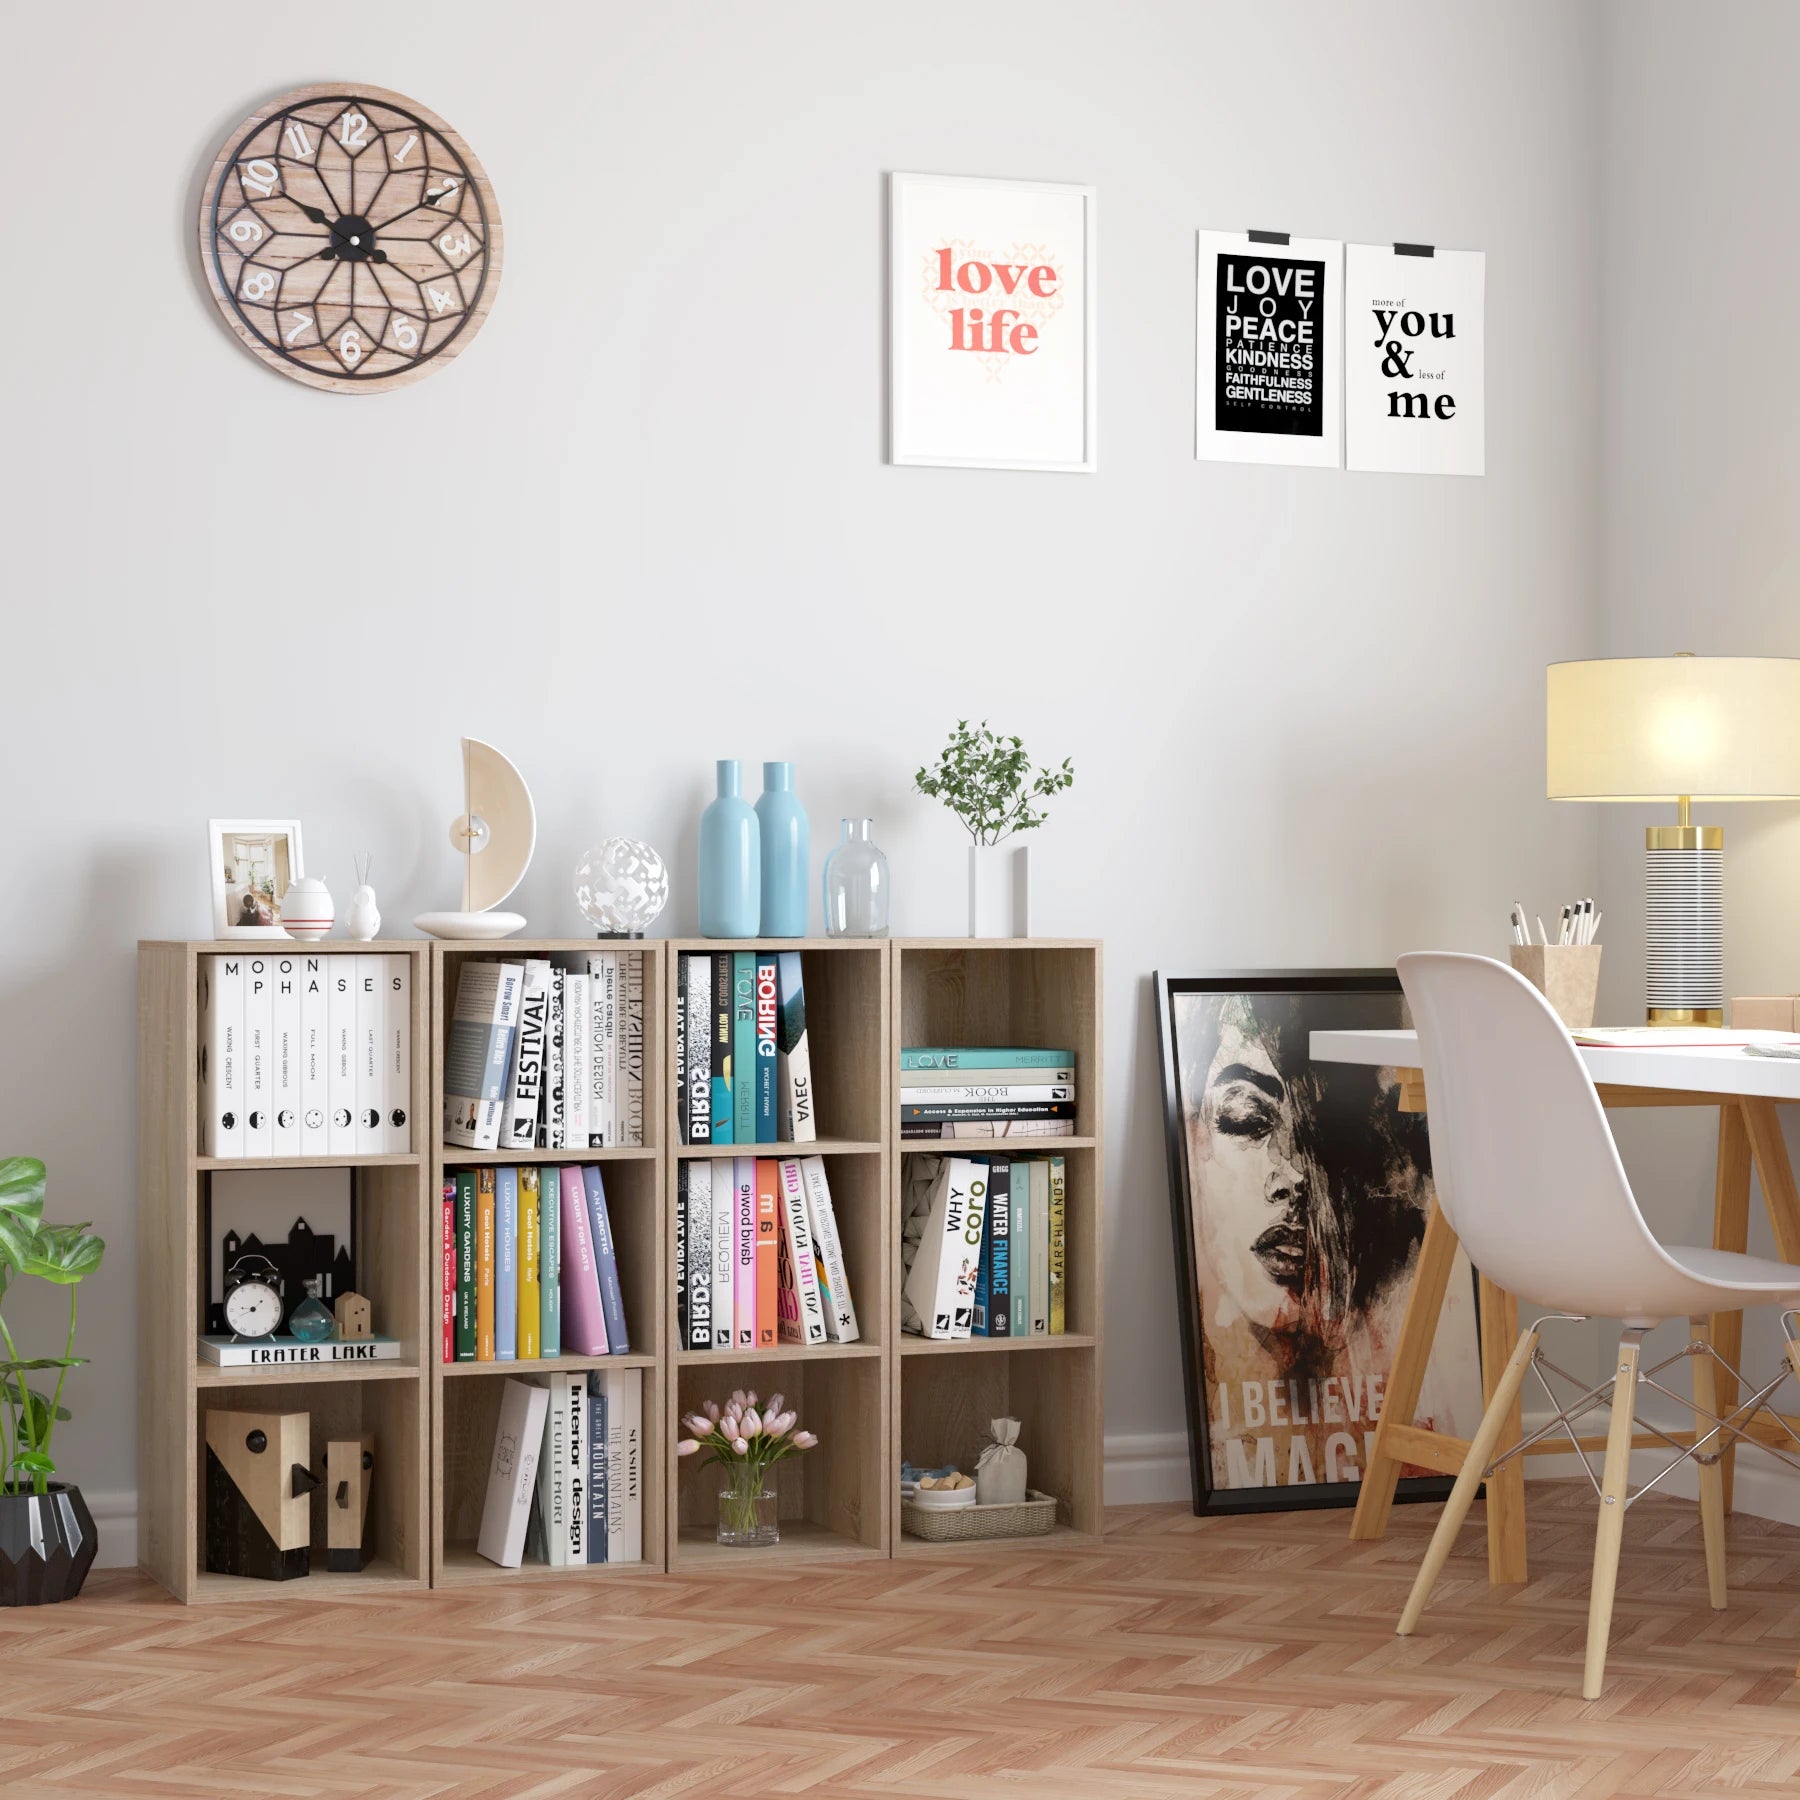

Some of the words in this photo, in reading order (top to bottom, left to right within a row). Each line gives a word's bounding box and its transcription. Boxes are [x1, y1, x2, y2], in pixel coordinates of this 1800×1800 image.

[285, 124, 315, 159] 11
[339, 112, 368, 146] 12
[393, 135, 418, 163] 1
[241, 159, 279, 198] 10
[229, 221, 262, 242] 9
[439, 234, 471, 255] 3
[242, 272, 275, 301] 8
[936, 248, 1057, 297] love
[1226, 264, 1315, 298] LOVE
[427, 288, 455, 313] 4
[1226, 295, 1313, 320] JOY
[1372, 298, 1394, 307] more
[1396, 299, 1406, 308] of
[286, 312, 314, 342] 7
[392, 317, 418, 349] 5
[948, 308, 1038, 355] life
[1226, 315, 1314, 344] PEACE
[1372, 309, 1456, 348] you
[340, 331, 361, 363] 6
[1226, 338, 1313, 355] PATIENCE
[1226, 348, 1314, 371] KINDNESS
[1381, 340, 1414, 379] &
[1226, 364, 1313, 378] GOODNESS
[1226, 372, 1312, 390] FAITHFULNESS
[1419, 369, 1434, 380] less
[1435, 370, 1446, 380] of
[1226, 384, 1312, 405] GENTLENESS
[1226, 400, 1252, 408] SELF
[1261, 403, 1312, 412] CONTROL
[1387, 391, 1456, 420] me
[225, 959, 318, 975] MOON
[254, 977, 401, 994] PHASES
[504, 977, 515, 1000] Borrow
[500, 1001, 513, 1021] Smart
[517, 992, 545, 1100] FESTIVAL
[1015, 1055, 1061, 1063] MERRITT
[908, 1054, 958, 1068] LOVE
[965, 1087, 1008, 1097] BOOK
[996, 1106, 1016, 1115] Higher
[1017, 1105, 1049, 1113] Education
[463, 1186, 471, 1229] LUXURY
[571, 1186, 582, 1224] LUXURY
[947, 1188, 964, 1232] WHY
[965, 1181, 985, 1245] coro
[993, 1193, 1008, 1236] WATER
[578, 1226, 586, 1245] FOR
[592, 1190, 609, 1255] ANTARCTIC
[1054, 1177, 1063, 1278] MARSHLANDS
[463, 1231, 471, 1283] GARDENS
[581, 1247, 590, 1271] CATS
[993, 1239, 1008, 1296] FINANCE
[251, 1348, 320, 1363] CRATER
[332, 1345, 378, 1360] LAKE
[1219, 1382, 1230, 1429] I
[1242, 1374, 1384, 1428] BELIEVE
[571, 1385, 583, 1470] Interior
[611, 1425, 622, 1445] THE
[554, 1411, 563, 1525] FEUILLEMORT
[629, 1429, 637, 1501] SUNSHINE
[592, 1443, 604, 1520] MOUNTAIN
[611, 1451, 622, 1534] MOUNTAINS
[570, 1478, 583, 1555] design
